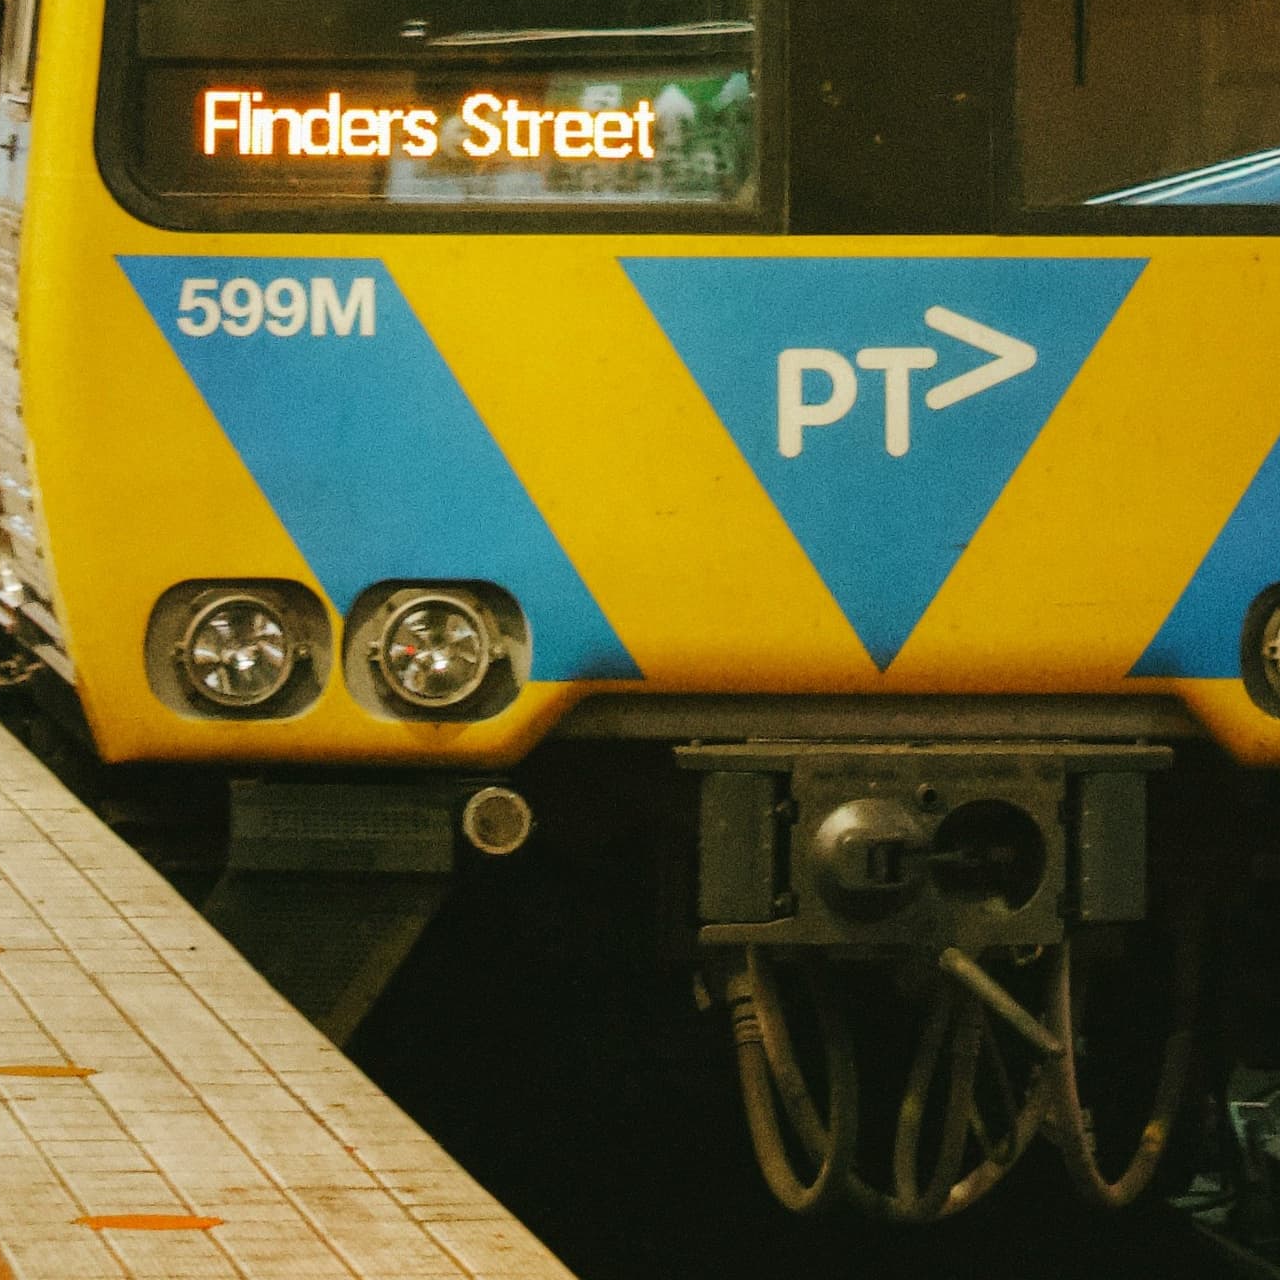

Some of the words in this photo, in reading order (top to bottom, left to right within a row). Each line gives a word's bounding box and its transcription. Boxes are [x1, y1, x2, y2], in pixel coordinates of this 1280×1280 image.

[202, 90, 438, 156] Flinders
[461, 93, 656, 158] Street
[175, 276, 377, 338] 599M
